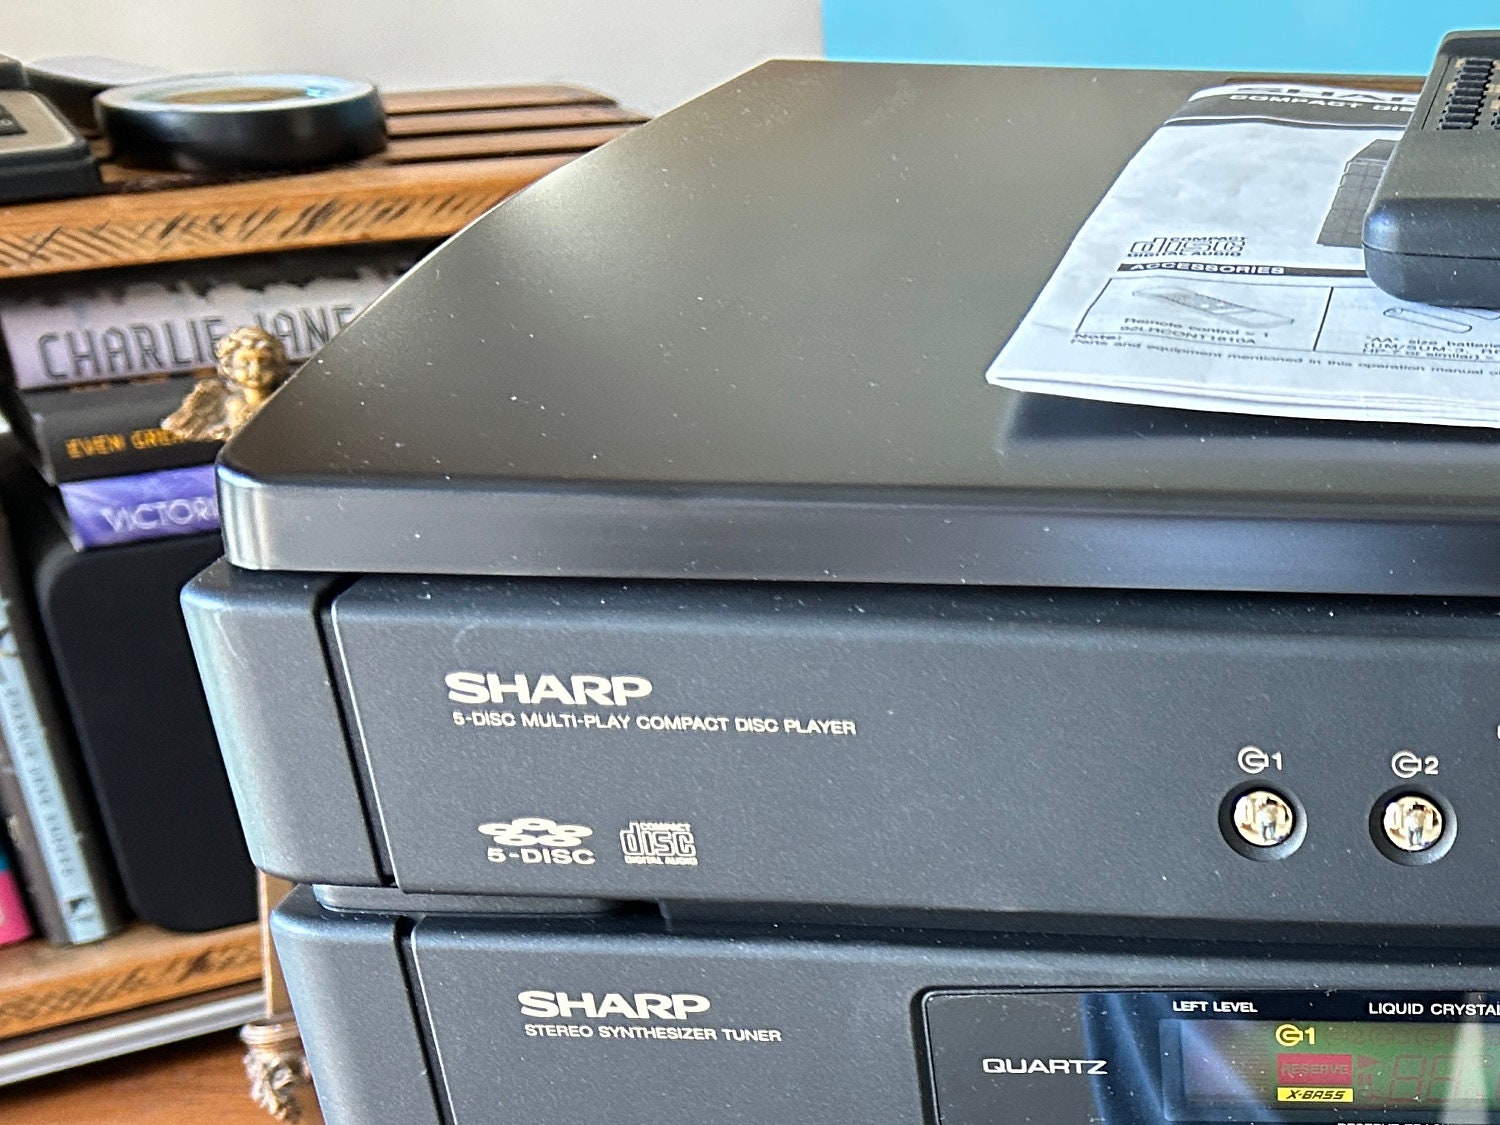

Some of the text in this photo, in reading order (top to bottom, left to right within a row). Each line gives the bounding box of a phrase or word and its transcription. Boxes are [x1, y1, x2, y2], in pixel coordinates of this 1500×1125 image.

[1230, 94, 1416, 112] COMPACT DIS
[1130, 262, 1286, 275] ACCESSORIES
[38, 313, 222, 382] CHARLIE
[66, 433, 127, 460] EVEN
[444, 671, 654, 707] SHARP
[453, 711, 857, 736] 5-DISC MULTI-PLAY COMPACT DISC PLAYER
[1272, 752, 1284, 771] 1
[1424, 756, 1440, 776] 2
[619, 821, 698, 858] disc
[487, 847, 596, 866] 5-DISC
[517, 990, 711, 1020] SHARP
[1172, 1000, 1259, 1014] LEFT LEVEL
[1368, 1002, 1425, 1017] LIQUID
[524, 1023, 783, 1042] STEREO SYNTHESIZER TUNER
[1304, 1029, 1316, 1045] 1
[981, 1058, 1108, 1076] QUARTZ
[1284, 1088, 1347, 1101] X-BASS
